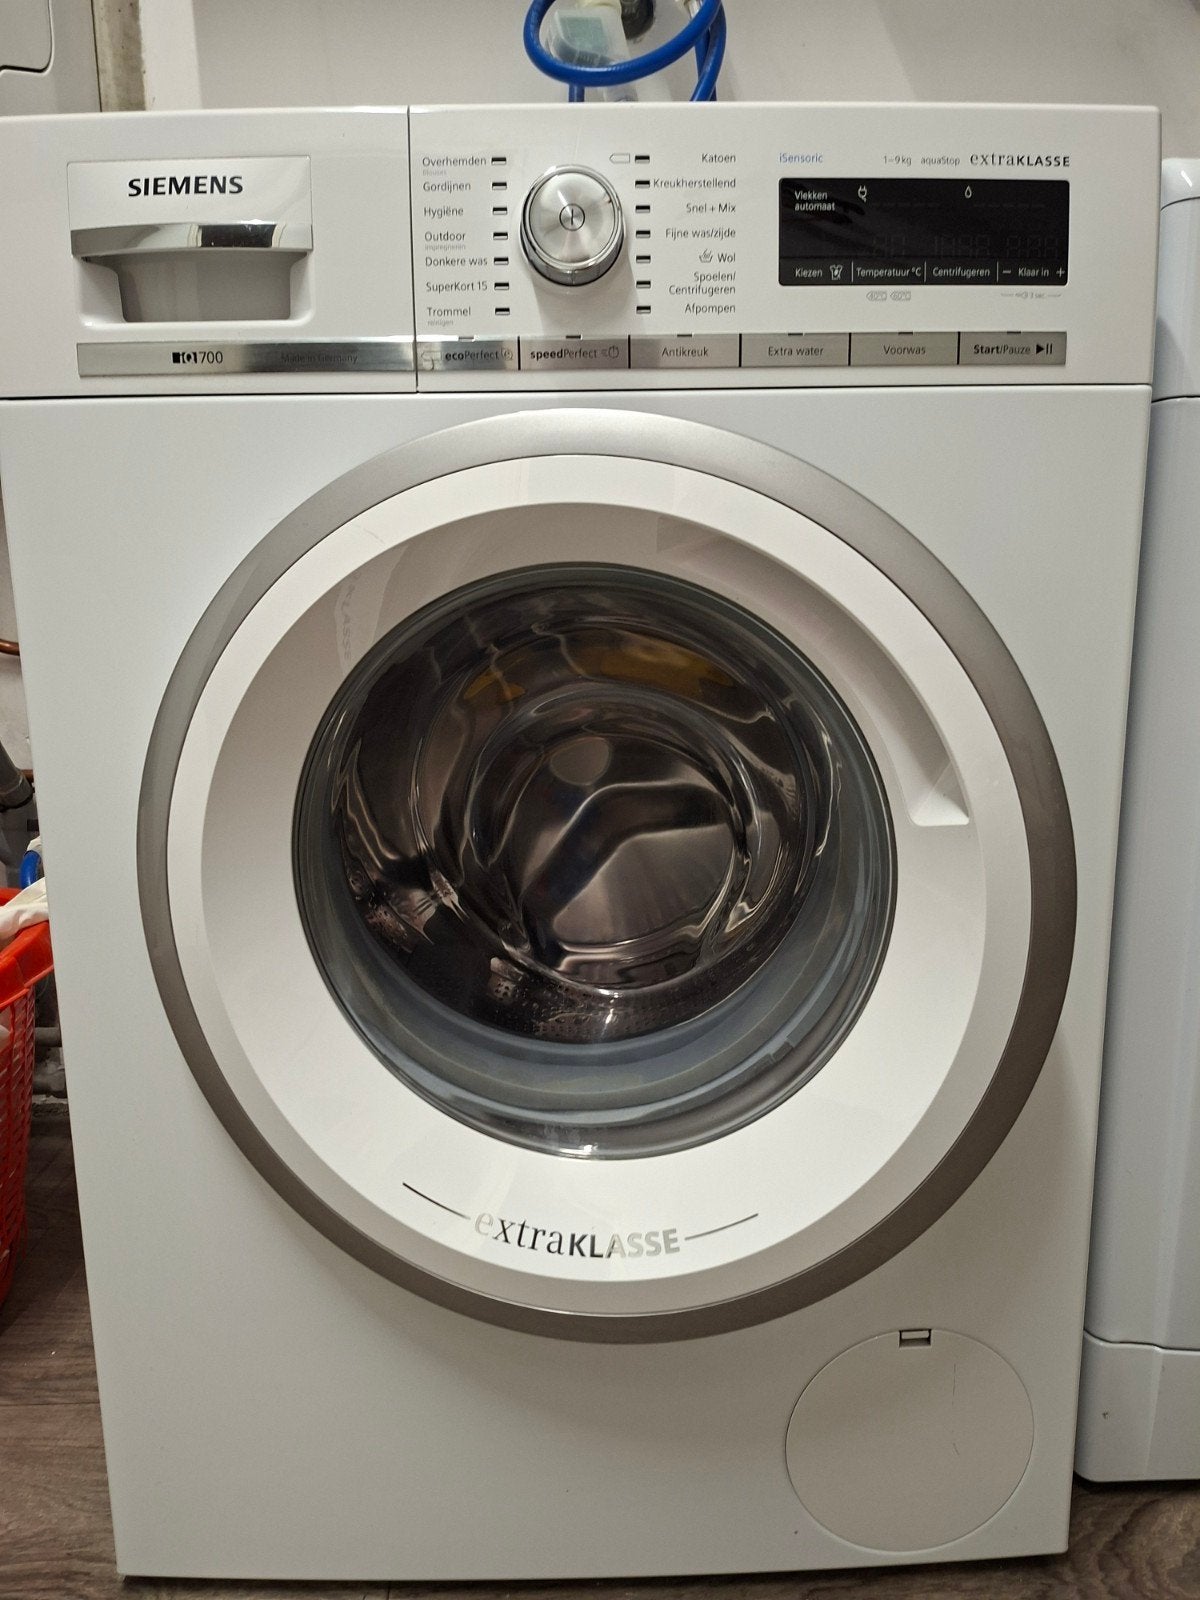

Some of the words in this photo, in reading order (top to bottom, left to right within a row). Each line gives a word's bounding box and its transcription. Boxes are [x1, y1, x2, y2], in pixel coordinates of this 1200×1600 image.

[422, 156, 487, 167] Overhemden
[701, 153, 736, 163] Katoen
[779, 153, 823, 163] iSensoric
[920, 156, 960, 167] aquaStop
[970, 152, 1070, 167] extraKLASSE
[128, 176, 243, 197] SIEMENS
[423, 181, 471, 194] Gordijnen
[653, 177, 736, 188] Kreukherstellend
[794, 190, 828, 200] Vlekken
[685, 203, 707, 213] Snel
[718, 203, 736, 213] Mix
[794, 202, 836, 211] automaat
[423, 206, 464, 219] Hygiëne
[424, 231, 466, 241] Outdoor
[665, 227, 689, 241] Fijne
[691, 227, 736, 241] was/zijde
[425, 256, 466, 267] Donkere
[468, 257, 487, 266] was
[717, 252, 736, 263] Wol
[795, 267, 823, 277] Kiezen
[856, 267, 910, 278] Temperatuur
[932, 267, 991, 279] Centrifugeren
[1018, 267, 1038, 277] Klaar
[1041, 267, 1050, 277] in
[426, 281, 475, 294] SuperKort
[477, 281, 488, 292] 15
[668, 284, 736, 297] Centrifugeren
[427, 306, 471, 317] Trommel
[684, 303, 736, 315] Afpompen
[445, 349, 499, 361] ecoPerfect
[662, 347, 708, 357] Antikreuk
[768, 346, 793, 357] Extra
[796, 347, 824, 357] water
[883, 345, 926, 355] Voorwas
[973, 344, 1031, 355] Start/Pauze
[530, 349, 597, 363] speedPerfect
[474, 1210, 681, 1259] extraKLASSE
